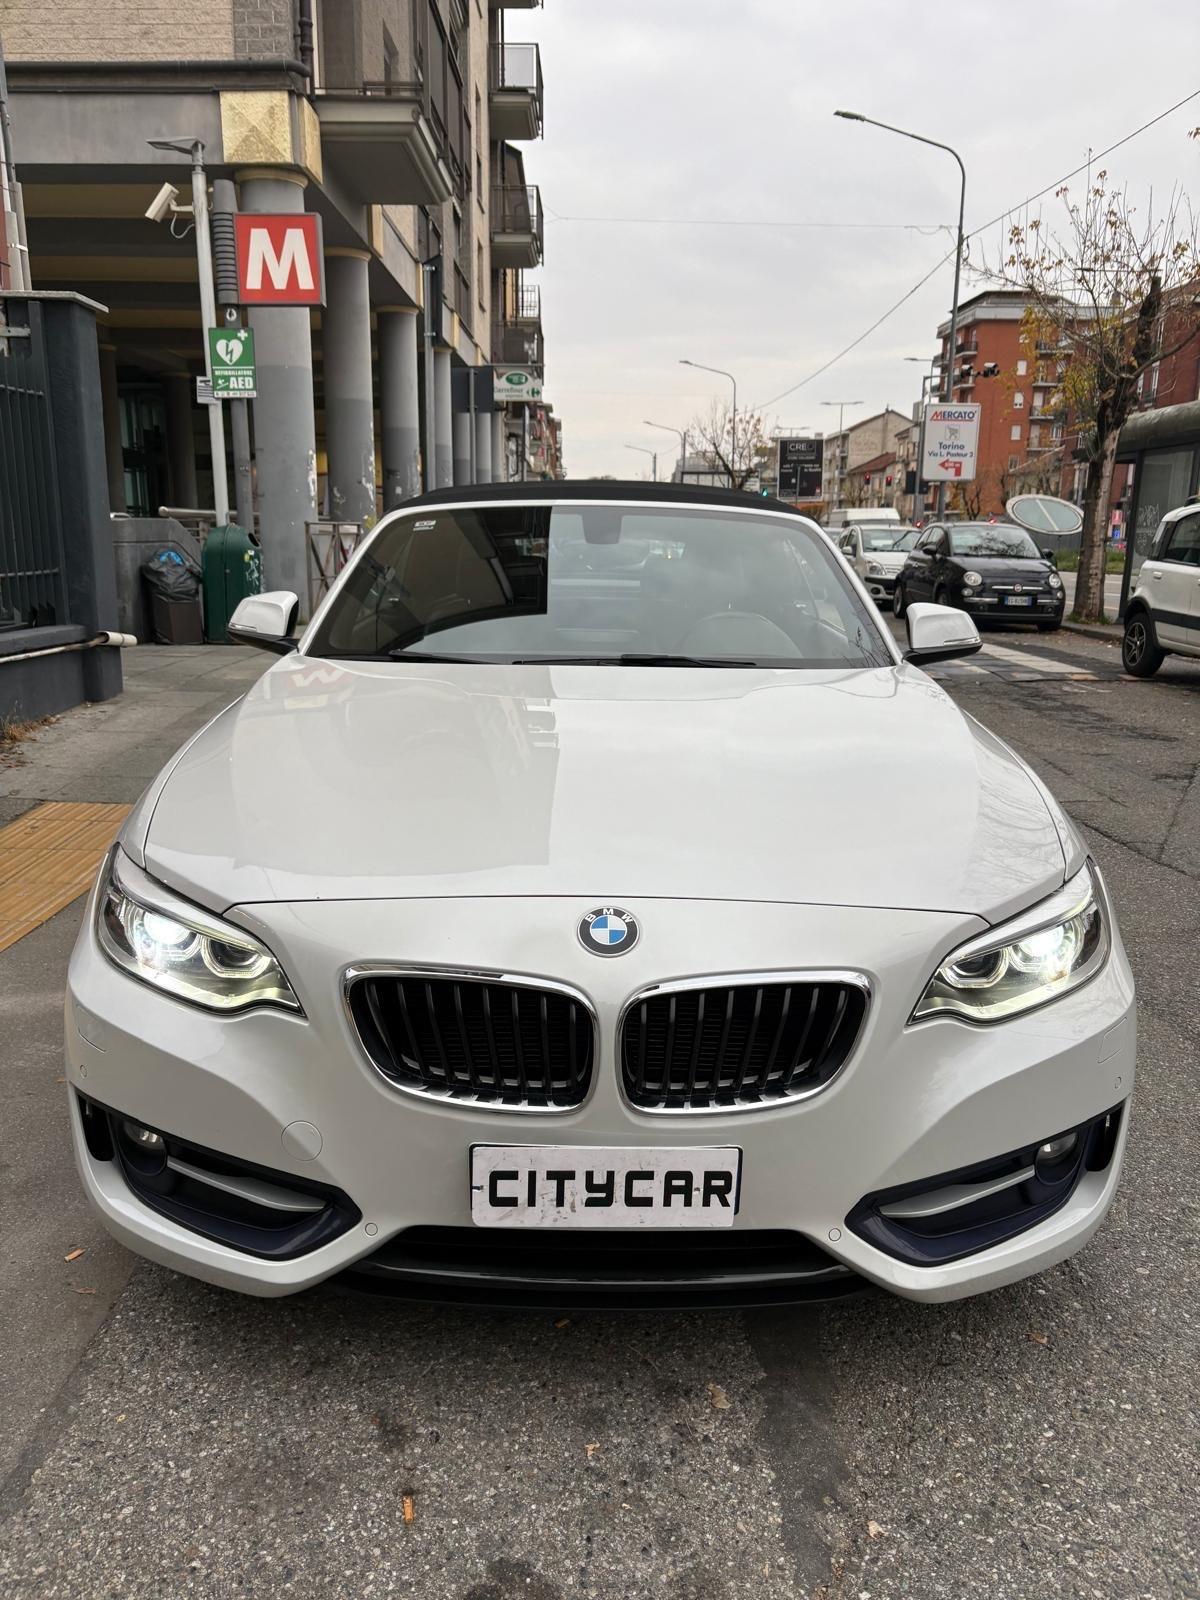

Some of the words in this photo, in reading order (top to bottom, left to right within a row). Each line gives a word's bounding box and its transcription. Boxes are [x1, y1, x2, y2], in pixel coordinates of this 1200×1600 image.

[245, 228, 315, 290] M
[229, 376, 254, 389] AED
[938, 442, 965, 450] Torino
[584, 908, 633, 923] BMW
[488, 1170, 734, 1208] CITYCAR
